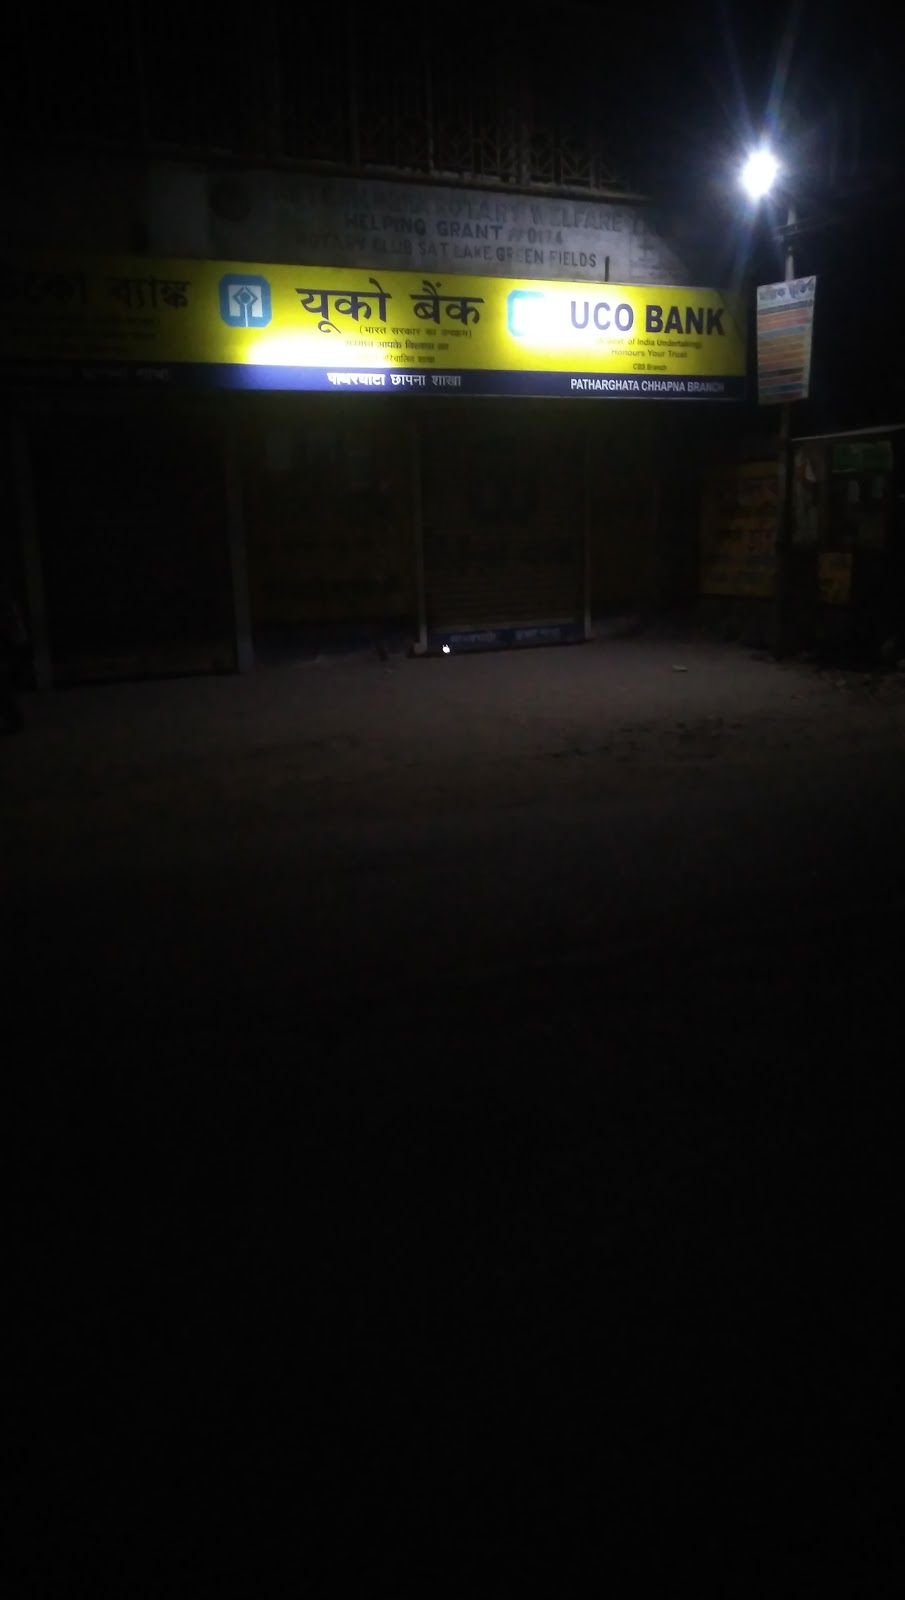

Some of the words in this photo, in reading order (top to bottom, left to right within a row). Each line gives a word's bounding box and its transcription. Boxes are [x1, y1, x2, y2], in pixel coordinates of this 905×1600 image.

[343, 212, 427, 237] HELPING
[436, 220, 503, 241] GRANT
[530, 203, 623, 233] WELFARE
[454, 245, 491, 261] LAKE
[495, 246, 544, 265] GREN
[551, 250, 598, 269] FIELDS
[295, 277, 392, 333] यूको
[409, 279, 484, 326] बैंक
[570, 300, 634, 332] UCO
[646, 304, 725, 337] BANK
[637, 338, 655, 347] India
[612, 348, 645, 357] Honours
[647, 349, 665, 358] Your
[668, 350, 688, 359] Trust
[632, 362, 646, 370] CBS
[647, 363, 667, 371] Branch
[390, 373, 425, 386] छापना
[431, 375, 461, 387] शाखा
[570, 378, 639, 391] PATHARGHATA
[641, 380, 685, 392] CHHAPNA
[687, 382, 724, 393] BRANCH
